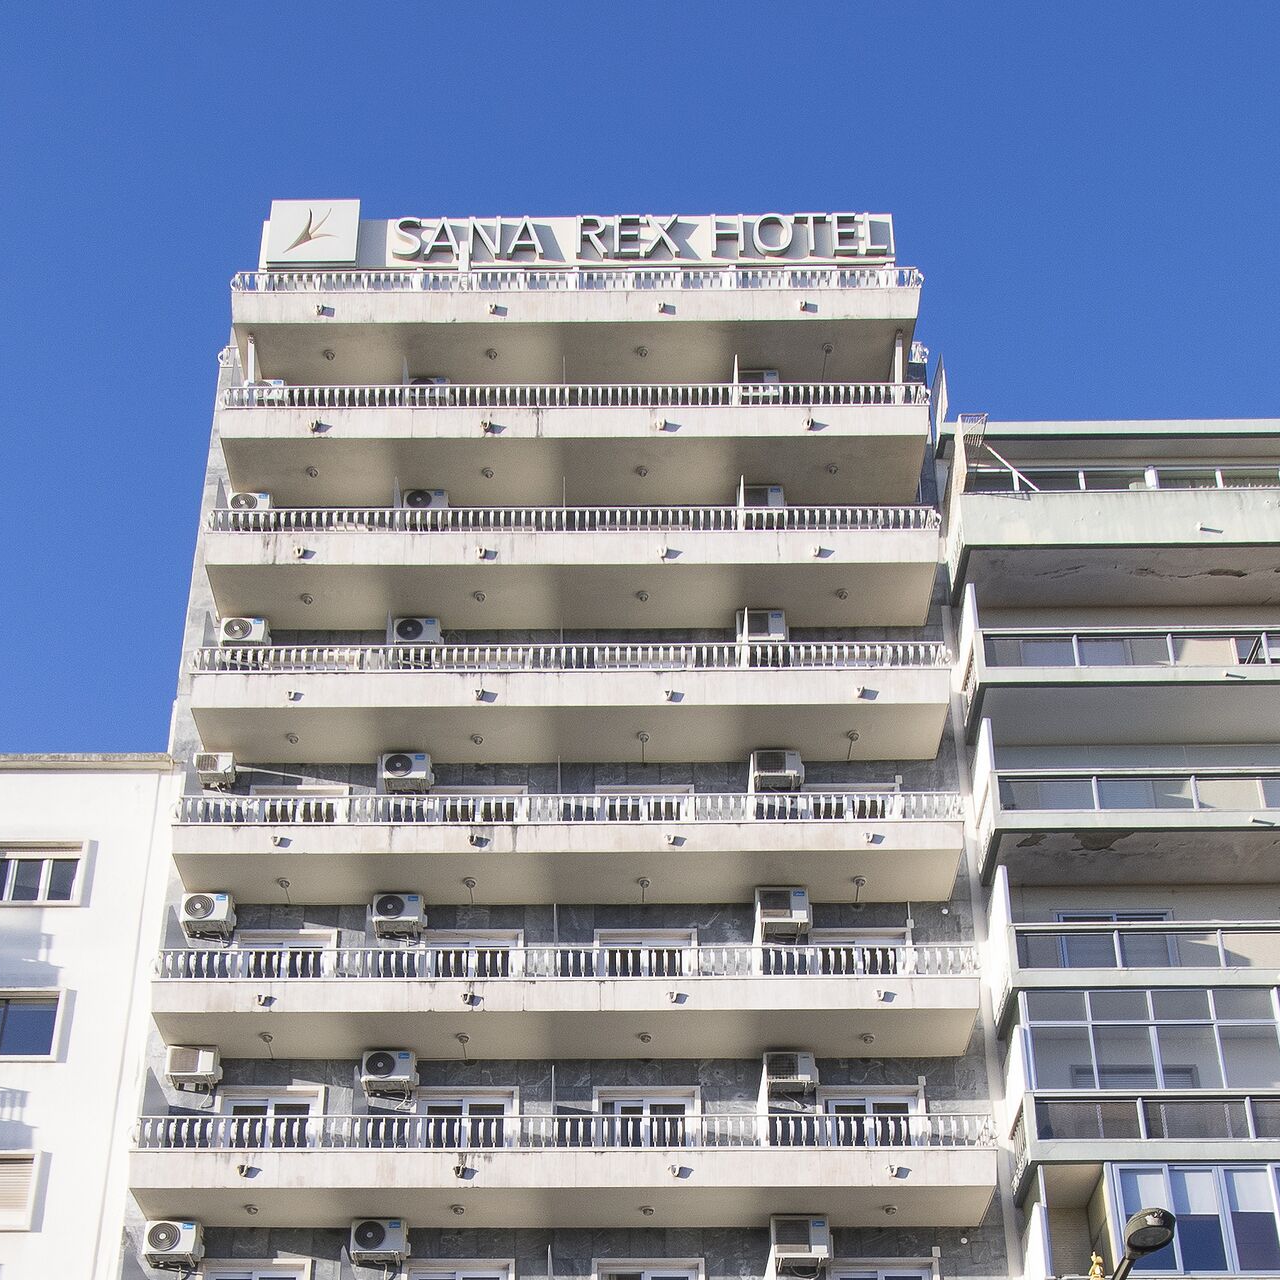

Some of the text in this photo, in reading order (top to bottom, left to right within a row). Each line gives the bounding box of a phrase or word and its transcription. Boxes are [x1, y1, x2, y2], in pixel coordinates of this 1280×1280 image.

[392, 213, 888, 261] SANA REX HOTEL
